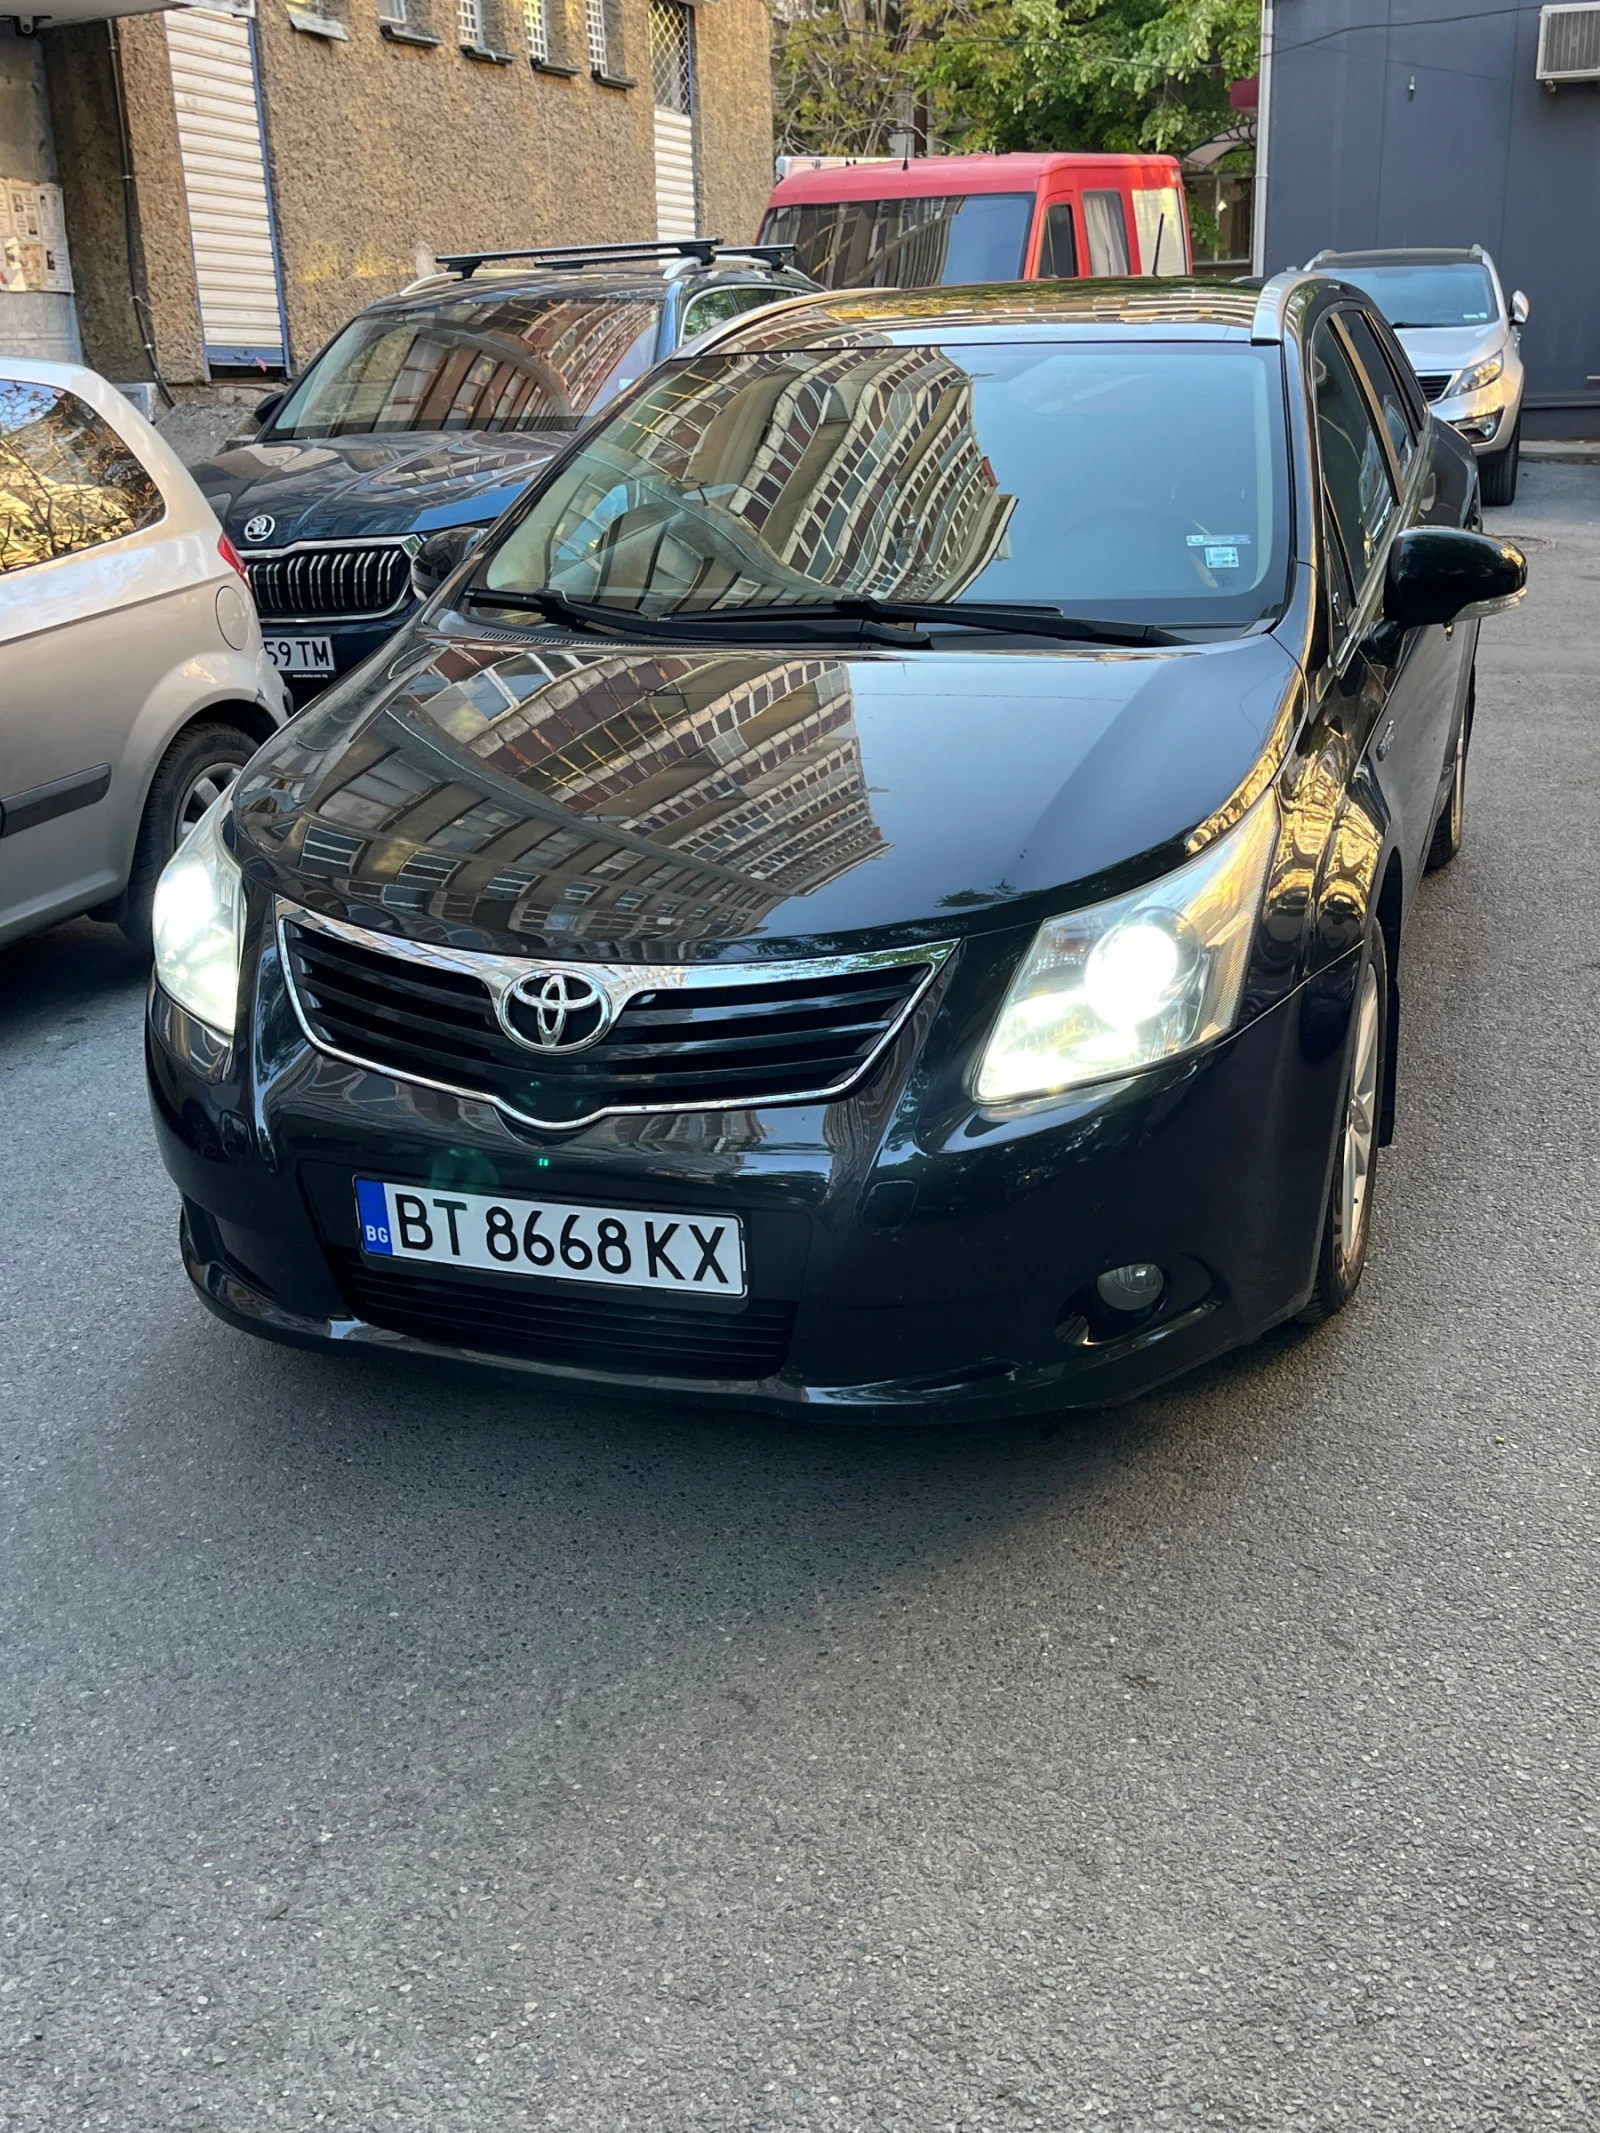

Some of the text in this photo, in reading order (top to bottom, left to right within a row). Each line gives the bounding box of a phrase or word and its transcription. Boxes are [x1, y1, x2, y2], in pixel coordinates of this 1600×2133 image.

[263, 641, 330, 667] 59 TM
[365, 1224, 389, 1243] BG
[394, 1193, 730, 1285] BT 8668 KX
